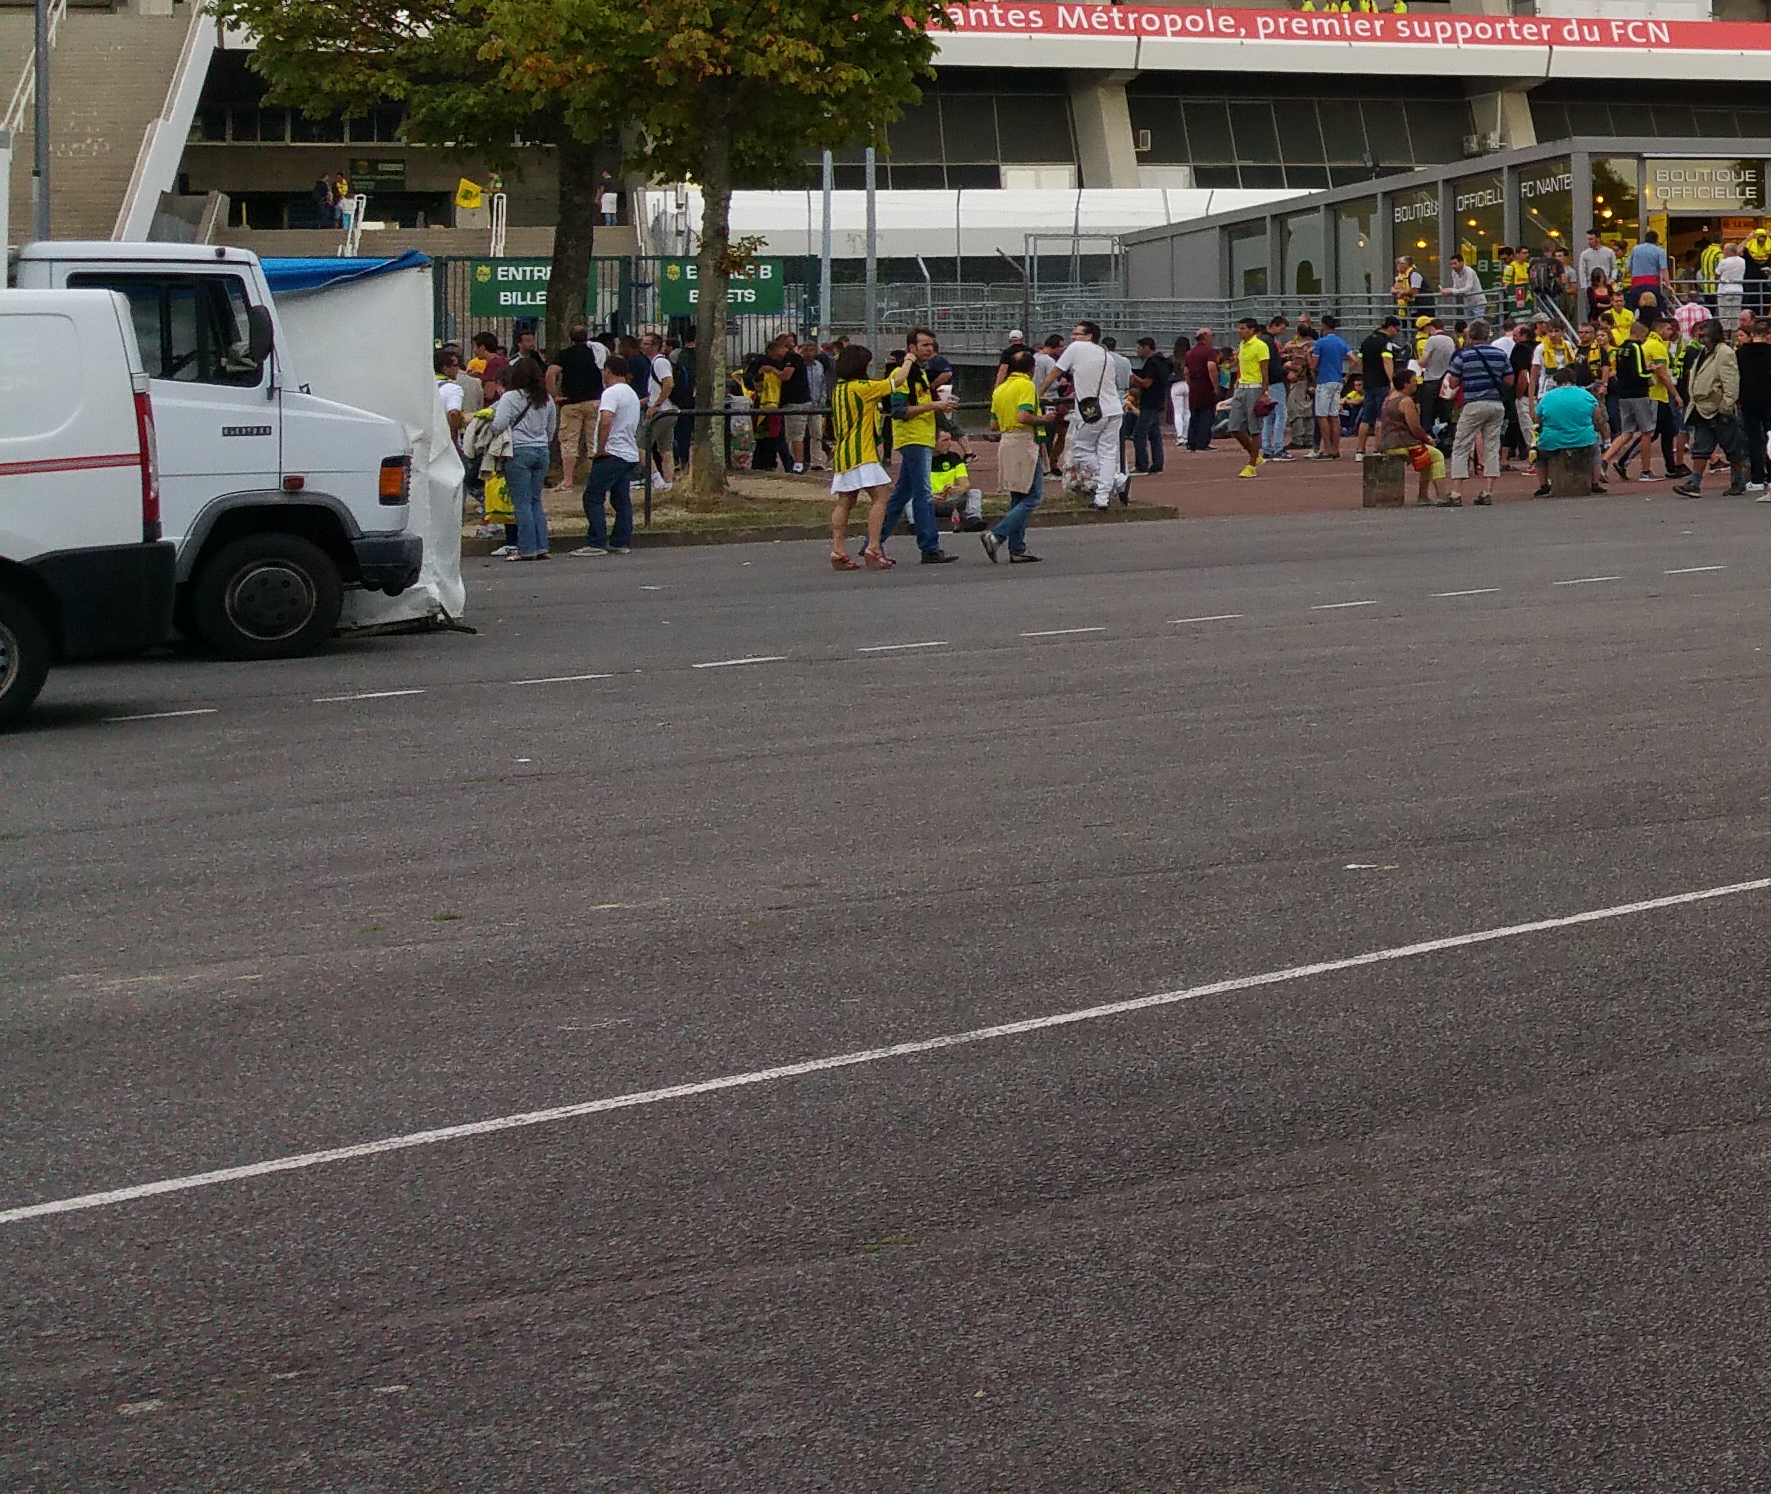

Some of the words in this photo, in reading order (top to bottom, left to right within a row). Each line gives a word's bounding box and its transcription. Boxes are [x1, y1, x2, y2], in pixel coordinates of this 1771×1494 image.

[937, 4, 1044, 28] antes
[1057, 5, 1246, 38] Métropole,
[1256, 13, 1385, 40] premier
[1396, 18, 1552, 45] supporter
[1563, 19, 1600, 42] du
[1610, 20, 1671, 44] FCN
[1656, 169, 1757, 182] BOUTIQUE
[1521, 181, 1535, 199] FC
[1656, 186, 1758, 199] OFFICIELLE
[1456, 187, 1504, 212] OFFICIELL
[1394, 201, 1439, 223] BOUTIQU
[497, 266, 552, 281] ENTR
[759, 264, 773, 280] B
[499, 291, 548, 306] BILLE
